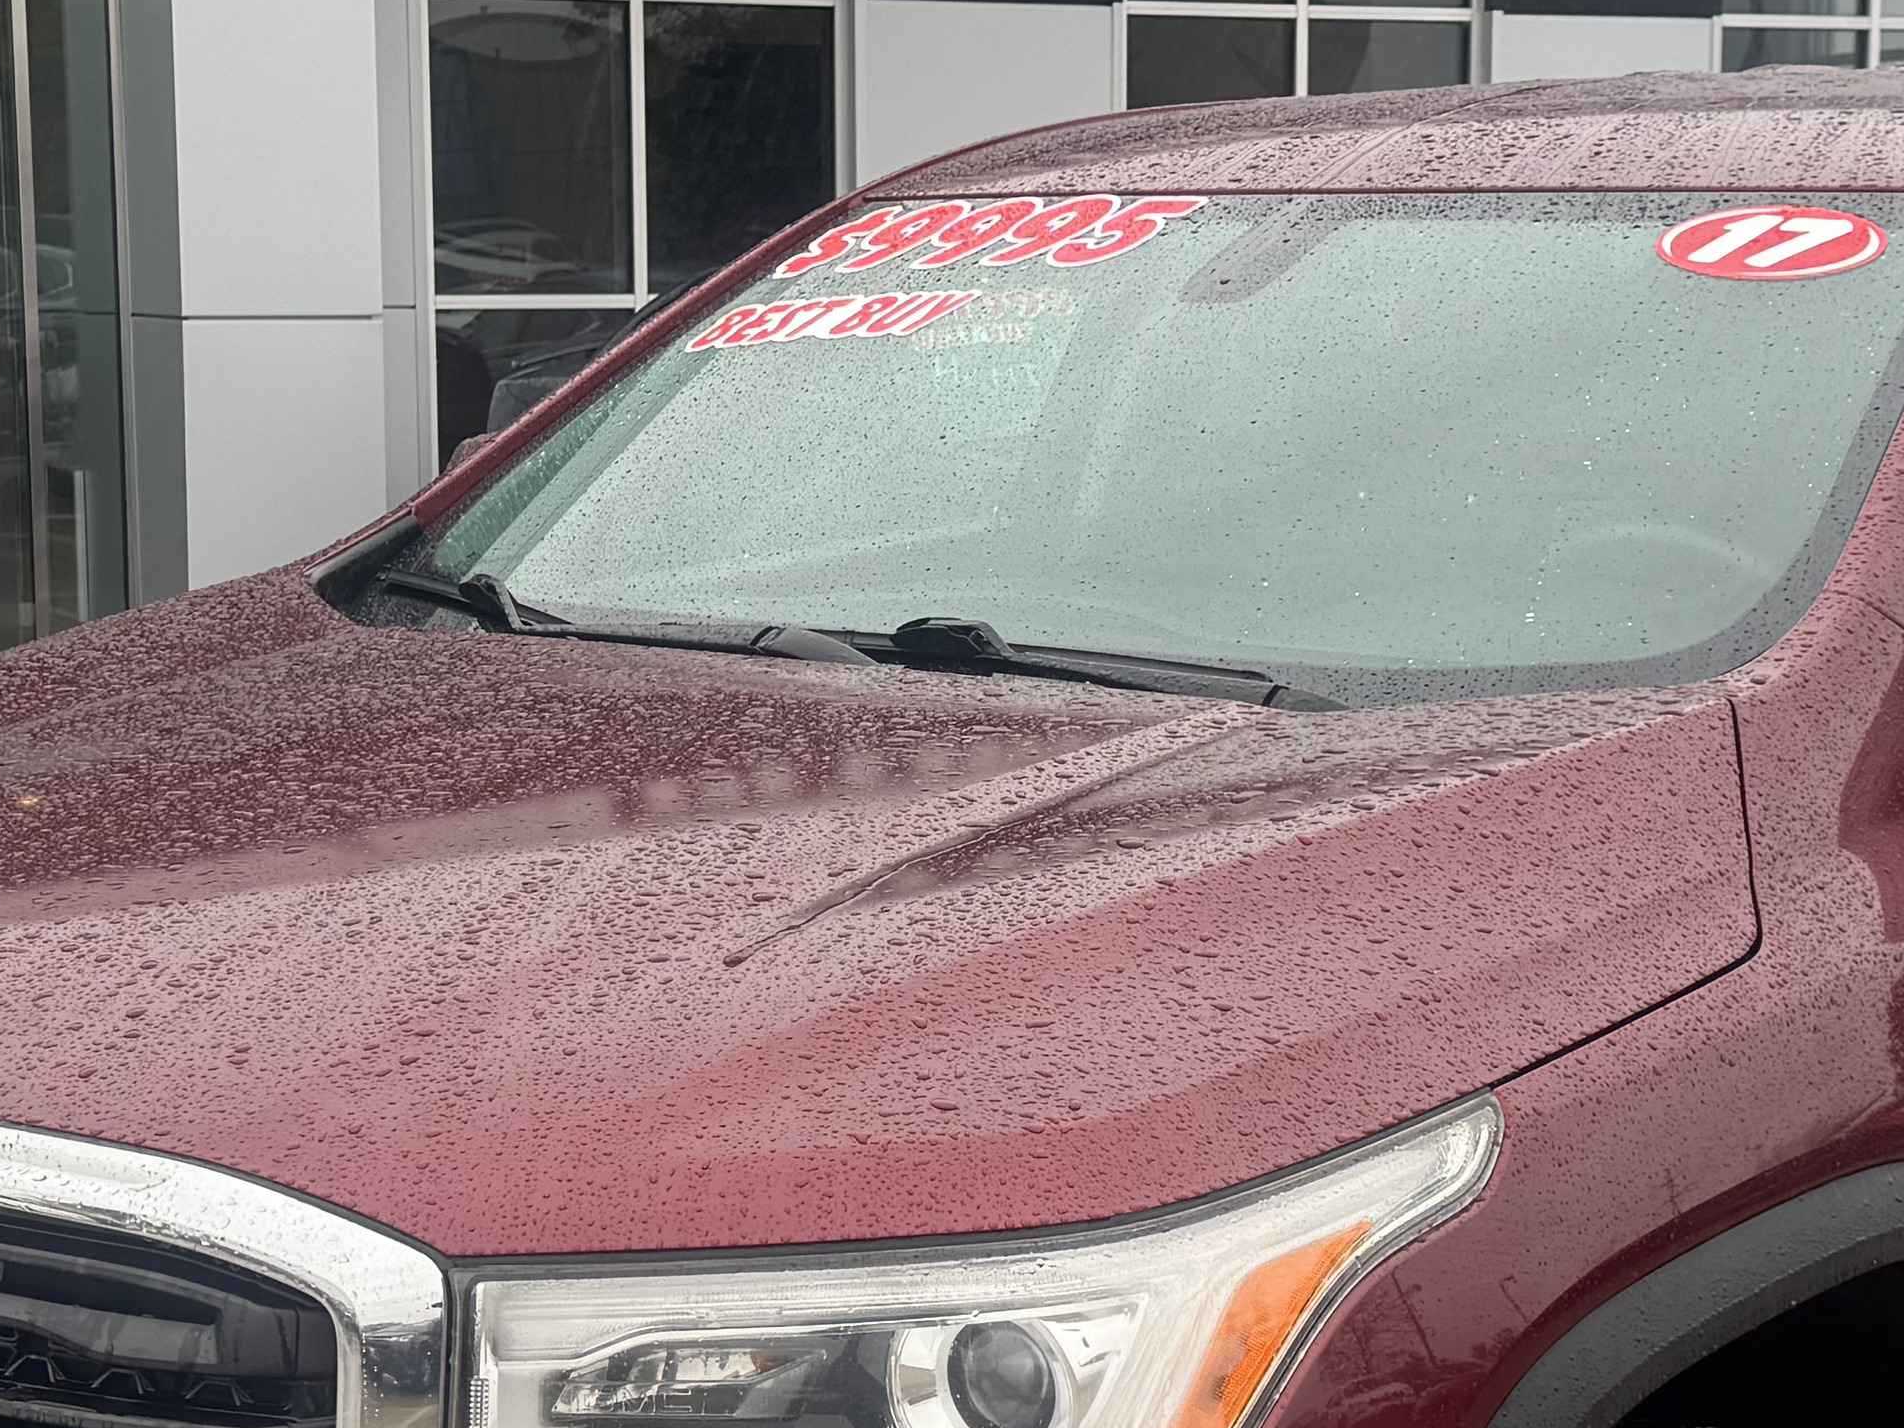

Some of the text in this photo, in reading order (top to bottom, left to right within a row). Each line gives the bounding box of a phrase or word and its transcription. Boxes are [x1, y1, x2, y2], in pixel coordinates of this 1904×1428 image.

[772, 193, 1209, 279] $9995
[1686, 214, 1854, 268] 17
[685, 295, 856, 353] BEST
[826, 289, 981, 340] BUY
